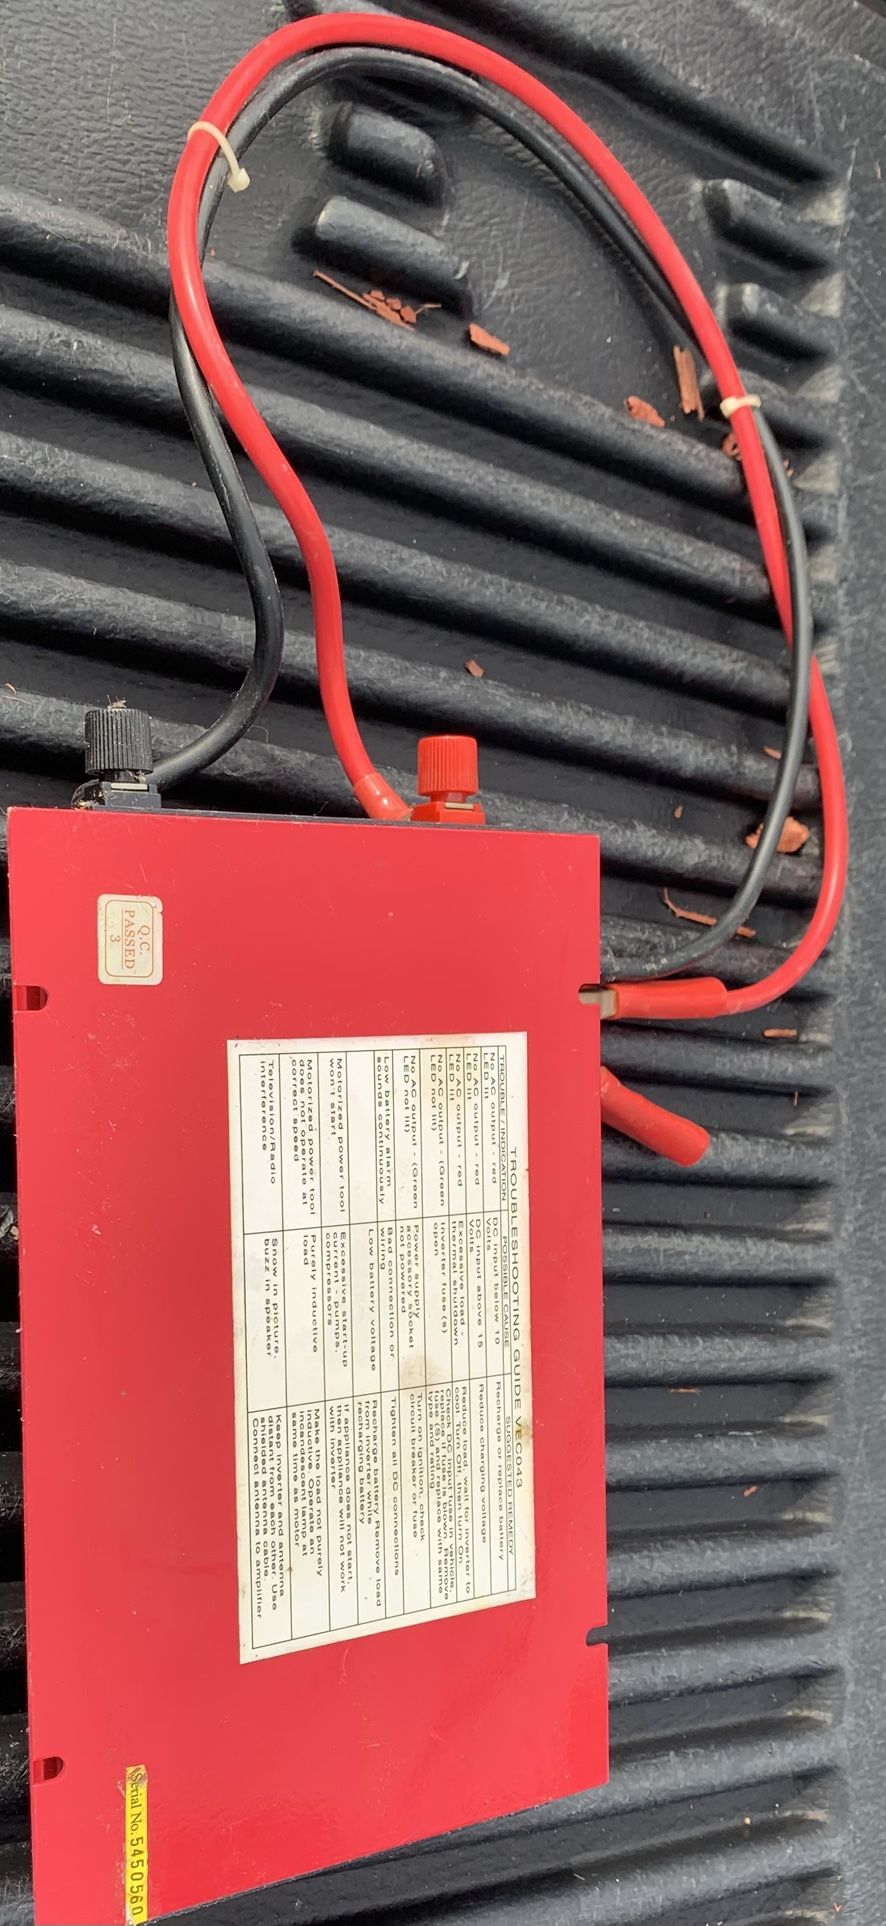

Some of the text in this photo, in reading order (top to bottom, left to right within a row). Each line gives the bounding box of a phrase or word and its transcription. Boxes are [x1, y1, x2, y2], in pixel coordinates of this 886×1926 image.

[110, 934, 120, 943] 3
[124, 910, 136, 970] PASSED
[137, 925, 150, 955] Q.C.
[377, 1113, 385, 1205] continuously
[399, 1253, 407, 1313] powered
[264, 1298, 273, 1357] speaker
[509, 1146, 523, 1489] TROUBLESHOOTING GUIDE VEC043
[260, 1416, 268, 1475] shielded
[299, 1410, 307, 1502] incandescent
[343, 1417, 351, 1482] appliance
[357, 1401, 365, 1473] recharging
[336, 1439, 344, 1504] appliance
[307, 1478, 315, 1534] Operate
[315, 1534, 324, 1577] purely
[255, 1559, 263, 1619] amplifier
[130, 1772, 144, 1916] Serial No. 5450560
